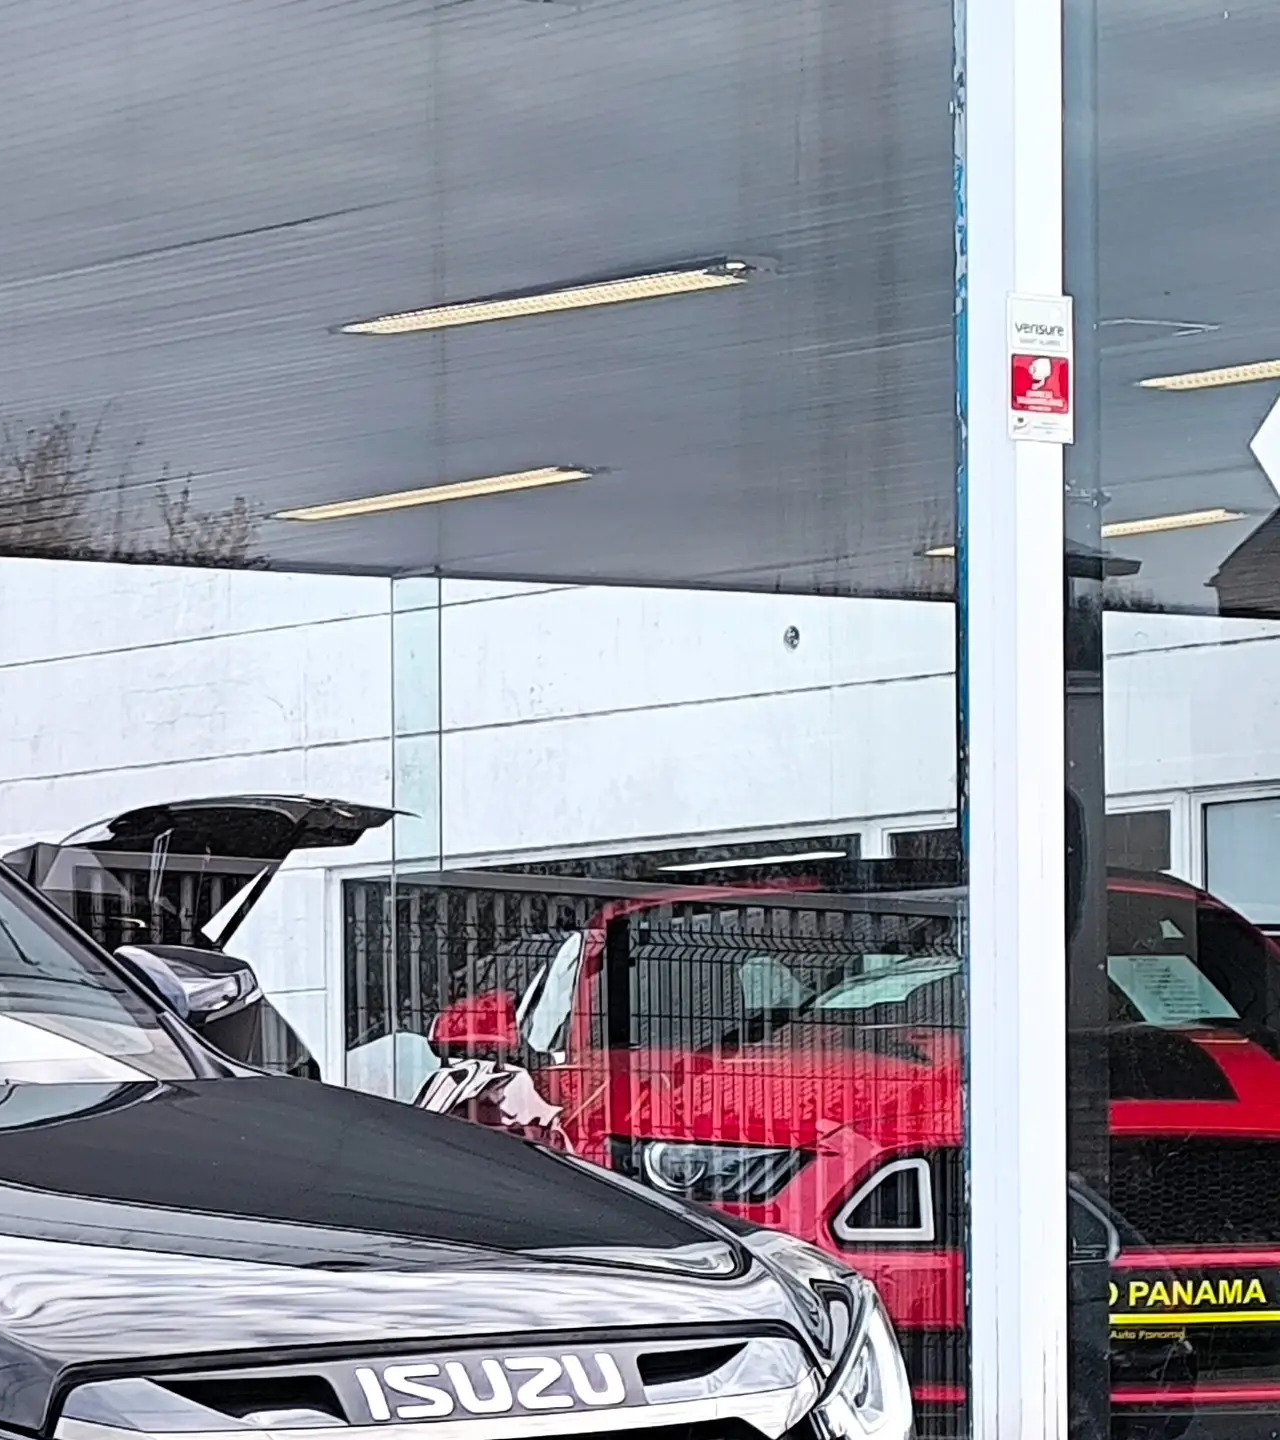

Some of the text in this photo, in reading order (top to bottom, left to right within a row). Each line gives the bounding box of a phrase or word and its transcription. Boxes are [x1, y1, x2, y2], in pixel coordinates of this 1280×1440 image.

[1014, 321, 1065, 337] verisure
[1129, 1279, 1267, 1307] PANAMA
[354, 1352, 627, 1422] ISUZU
